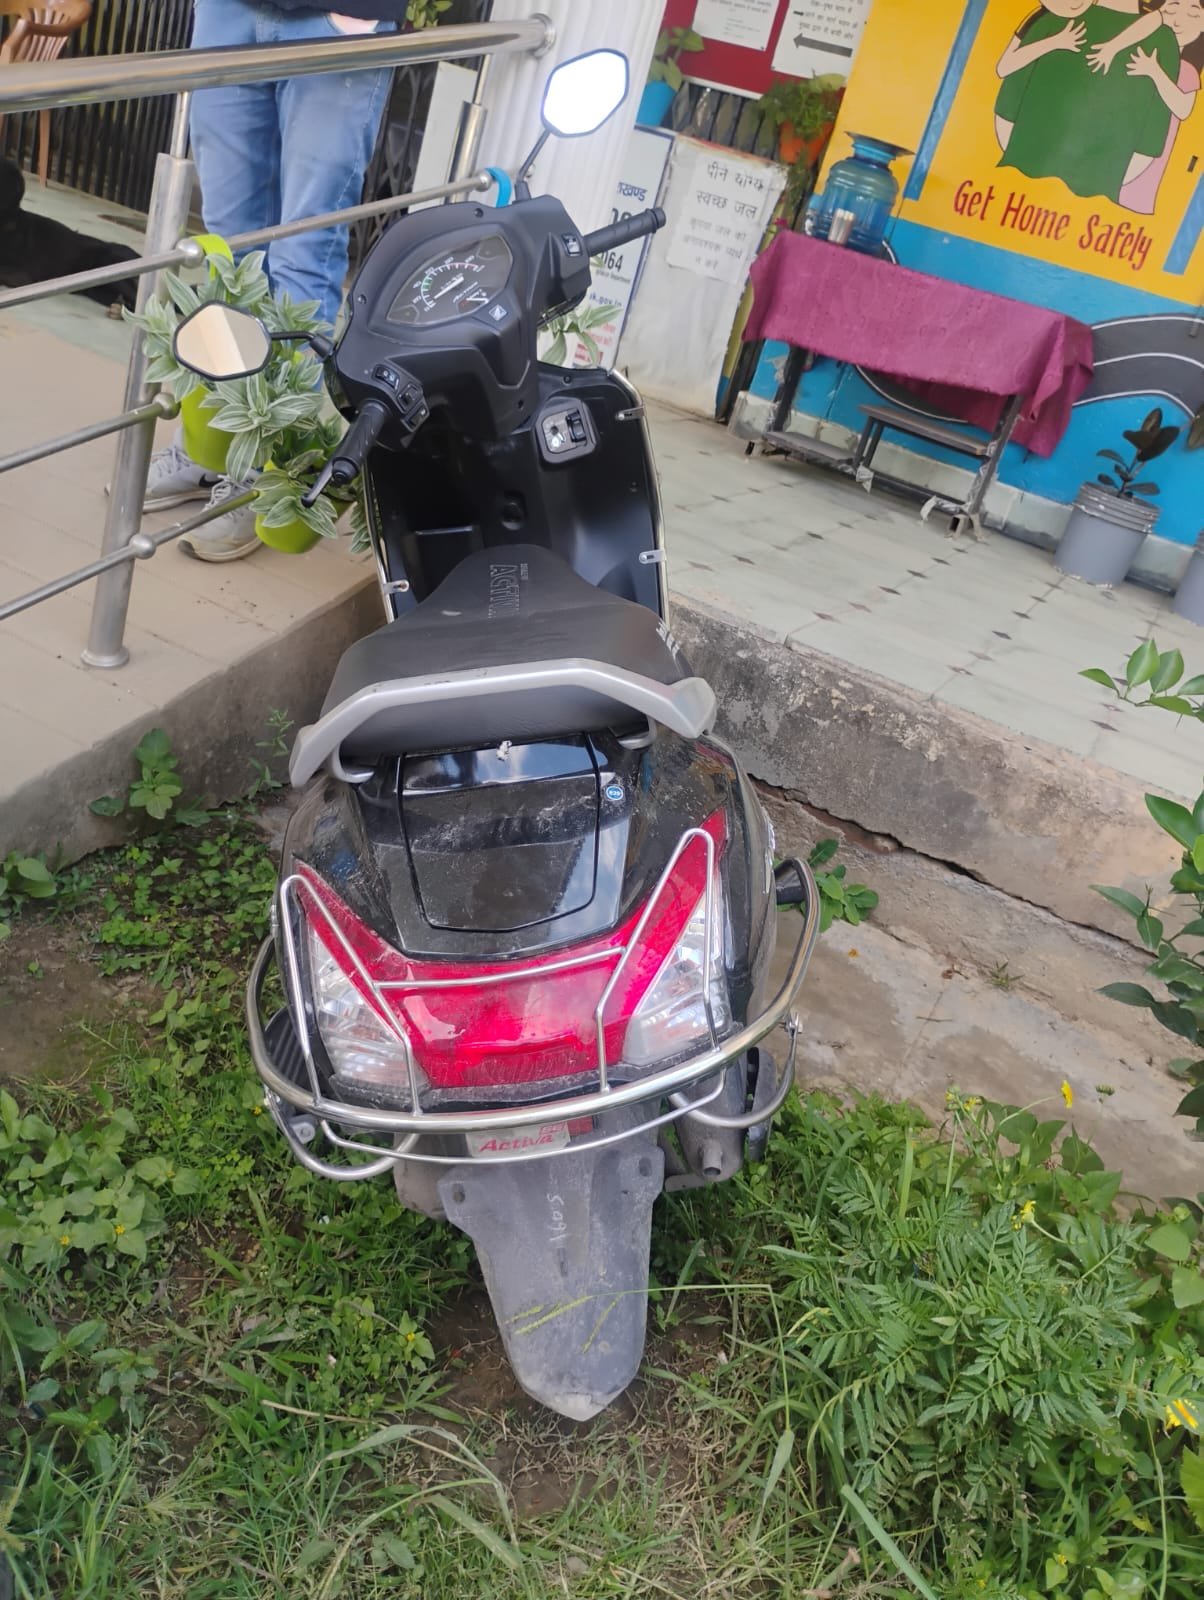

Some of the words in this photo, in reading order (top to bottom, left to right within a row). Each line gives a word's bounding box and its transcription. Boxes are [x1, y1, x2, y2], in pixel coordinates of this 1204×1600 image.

[696, 190, 728, 209] स्वच्छ
[734, 200, 758, 219] जल
[953, 180, 995, 221] Get
[1000, 192, 1070, 240] Home
[1078, 214, 1152, 270] Safely
[478, 1134, 554, 1153] Activa
